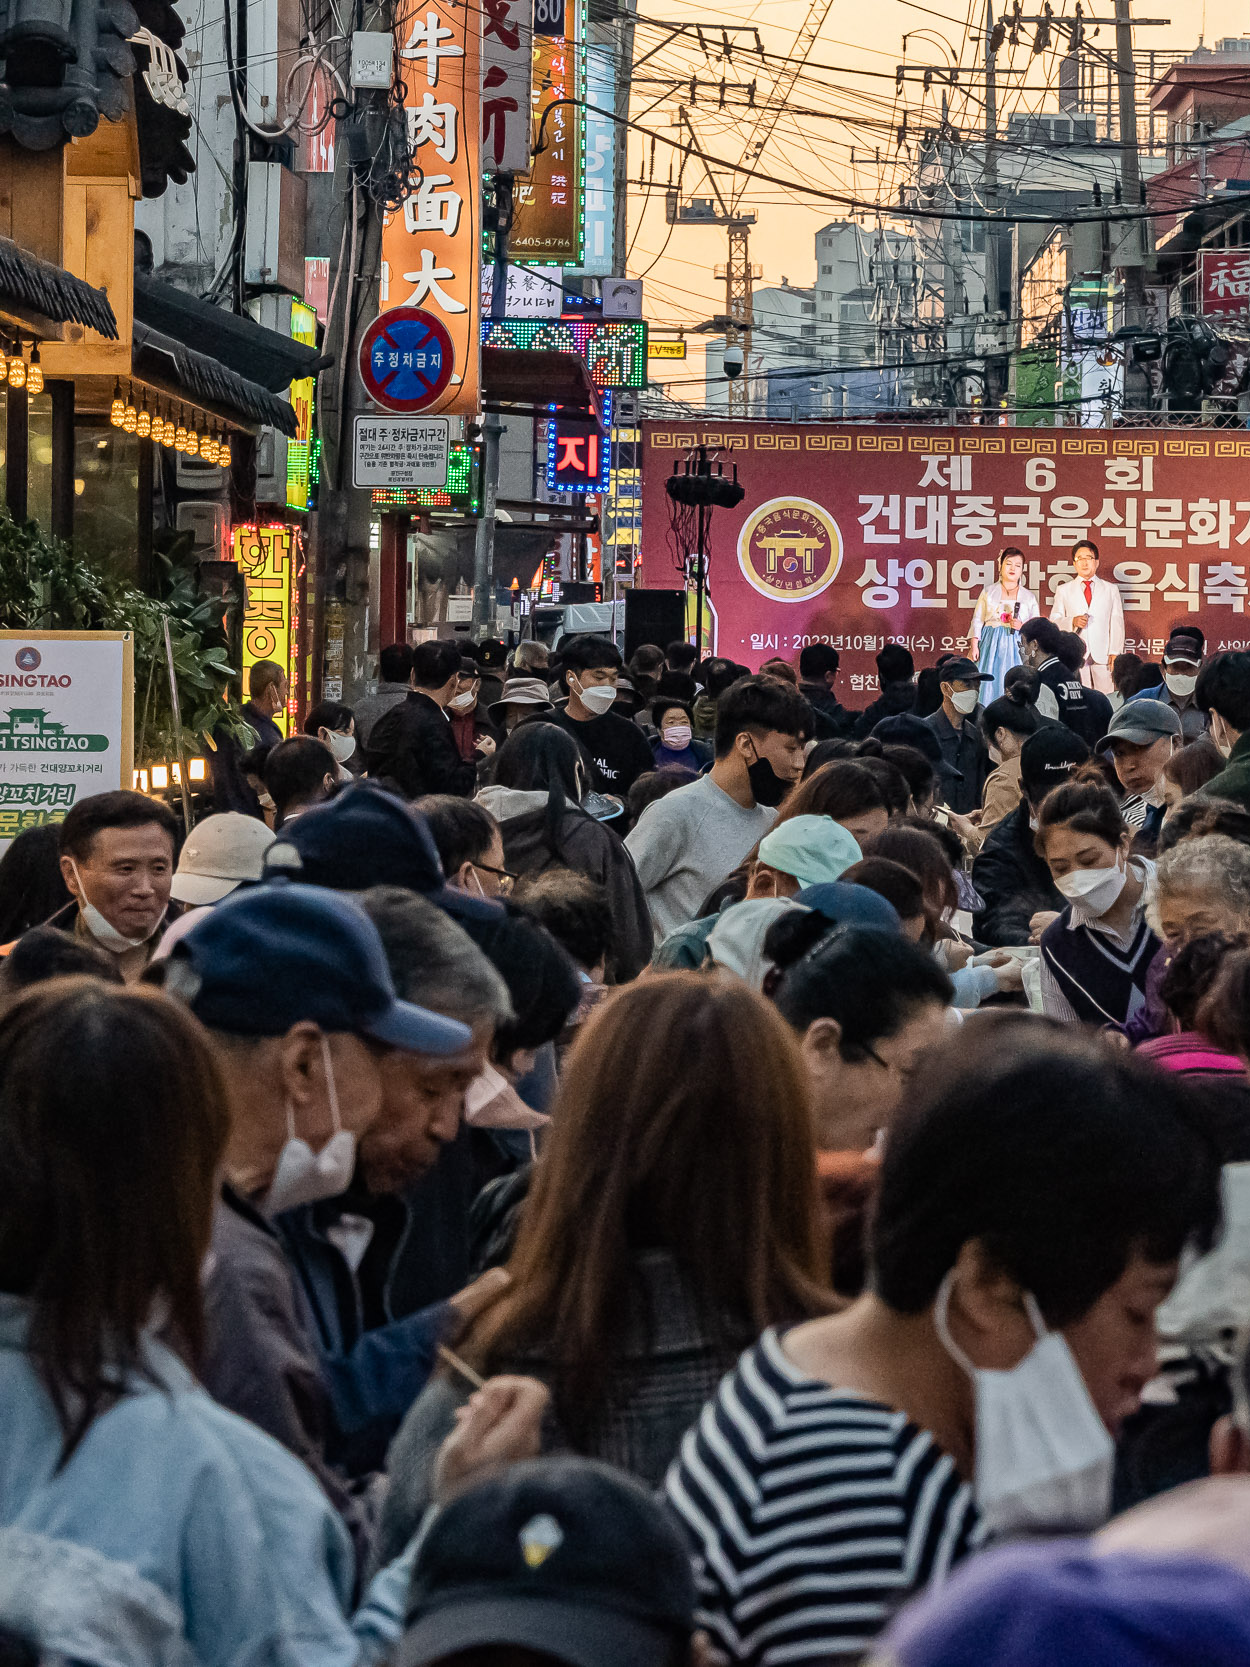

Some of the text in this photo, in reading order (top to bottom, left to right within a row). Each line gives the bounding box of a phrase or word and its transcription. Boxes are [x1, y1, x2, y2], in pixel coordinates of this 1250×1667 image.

[400, 11, 466, 384] 牛肉面大
[373, 350, 442, 369] 주정차금지
[358, 427, 446, 442] 절대 주·정차금지구간
[917, 454, 1154, 493] 제 6 회
[750, 633, 779, 650] 일시
[939, 636, 972, 652] 오후
[0, 674, 72, 689] SINGTAO
[11, 736, 90, 750] TSINGTAO
[10, 763, 37, 774] 가득한
[40, 763, 103, 774] 건대양꼬치거리
